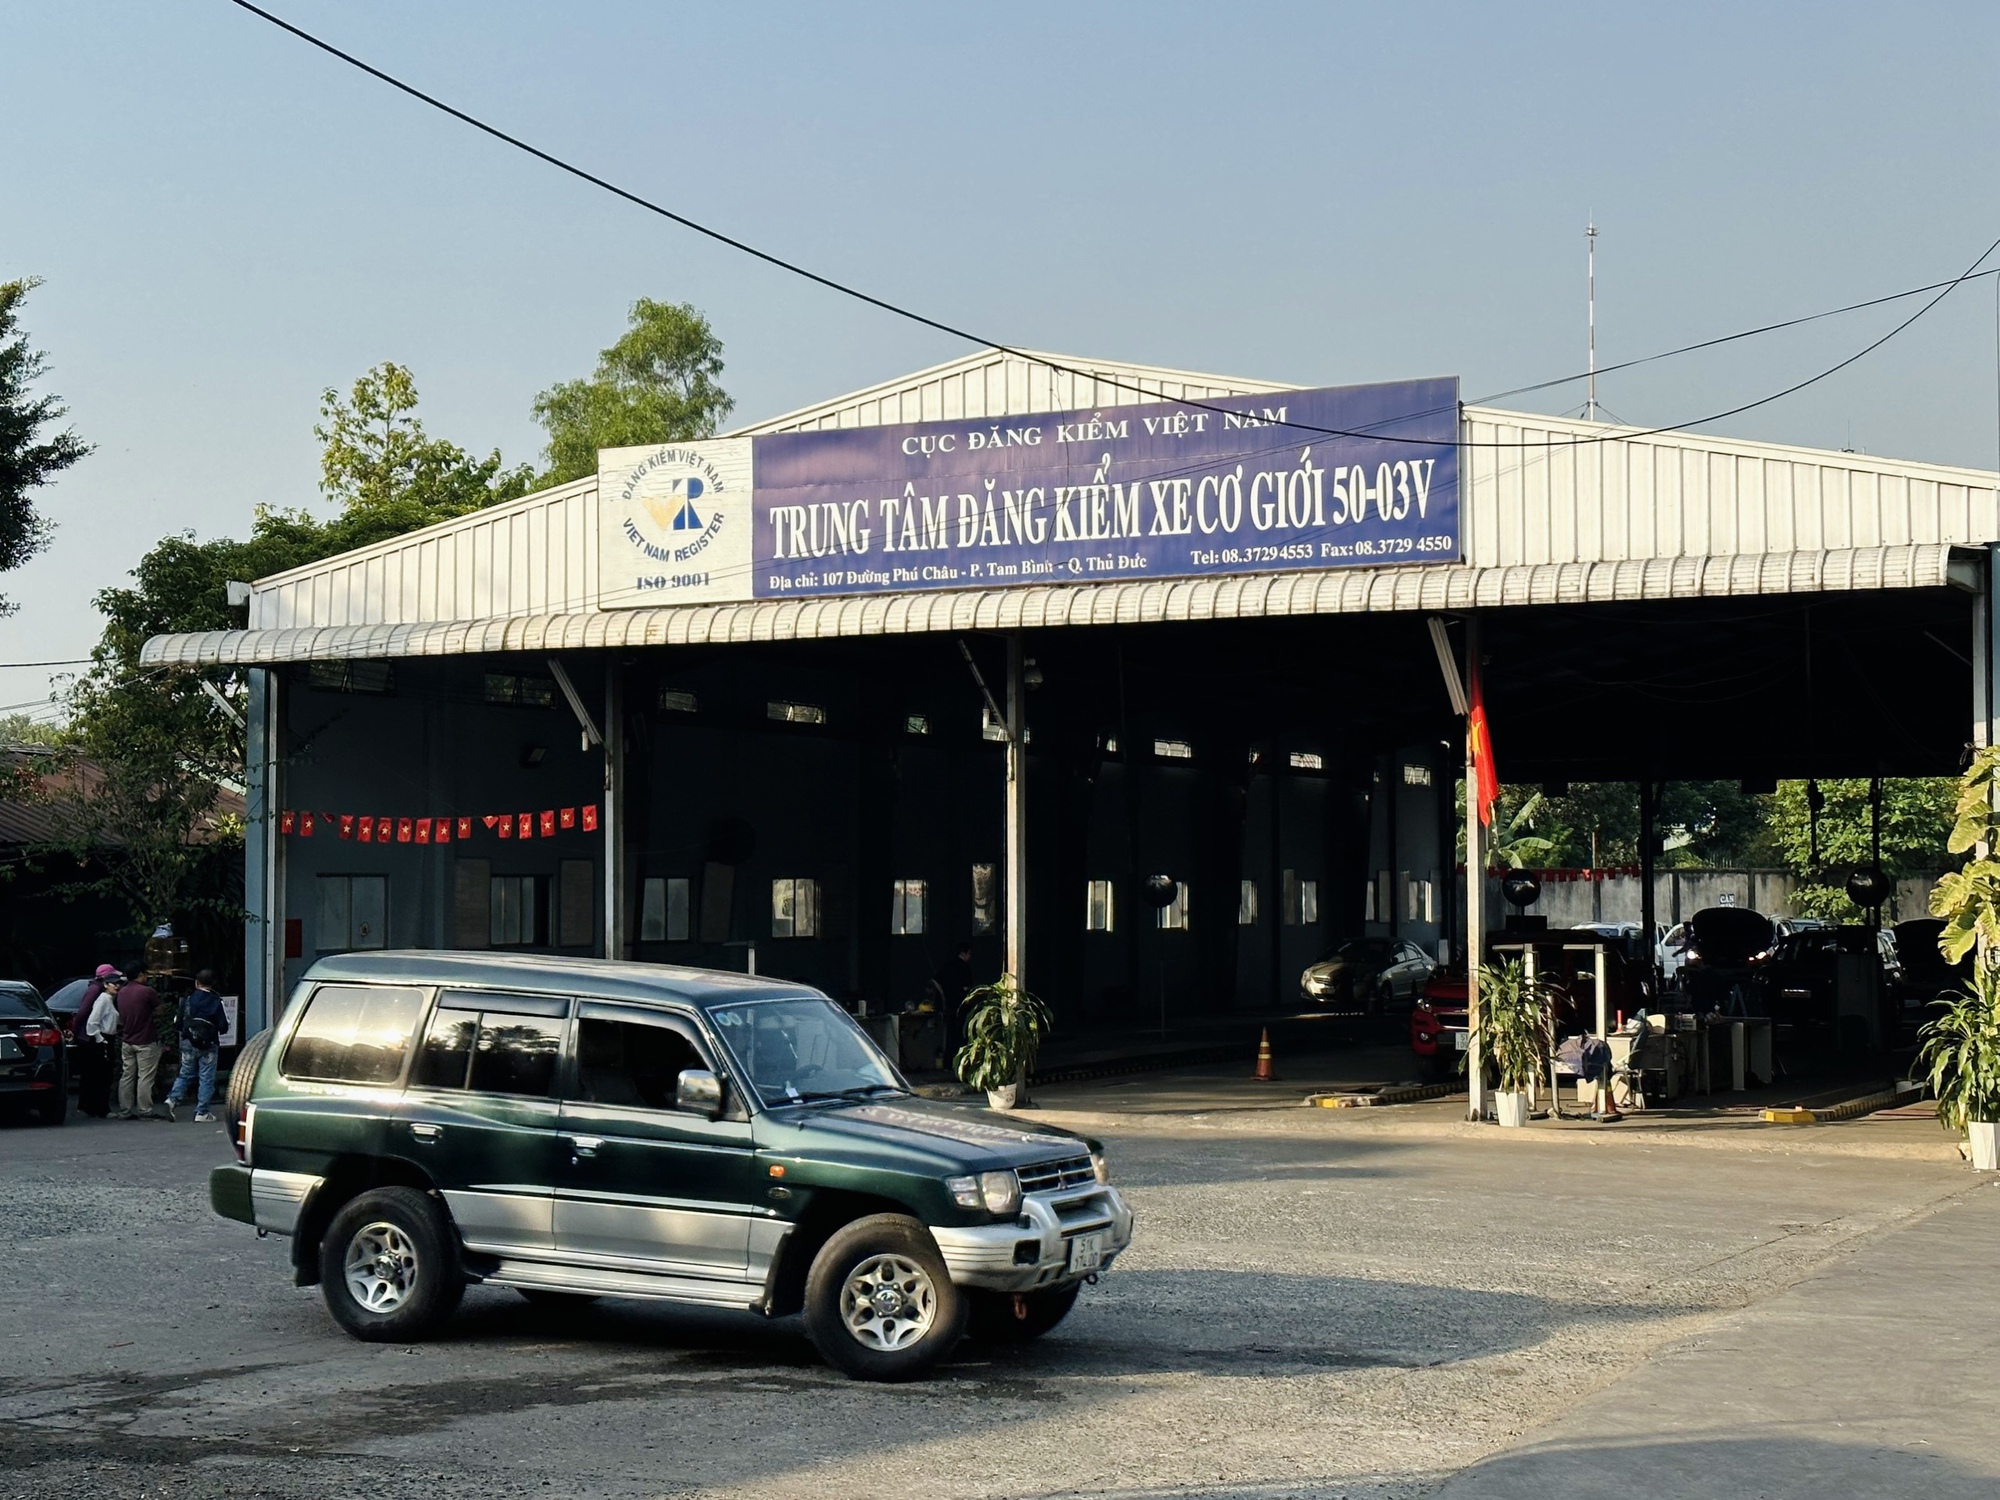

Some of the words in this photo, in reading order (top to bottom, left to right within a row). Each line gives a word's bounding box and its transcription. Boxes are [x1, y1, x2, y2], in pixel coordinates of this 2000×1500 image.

[901, 434, 956, 458] CỤC
[967, 425, 1043, 451] ĐĂNG
[1056, 412, 1129, 443] KIỂM
[1142, 410, 1209, 438] VIỆT
[1223, 406, 1288, 430] NAM
[703, 463, 725, 493] NAM
[769, 499, 871, 560] TRUNG
[880, 481, 949, 553] TÂM
[957, 478, 1047, 549] ĐĂNG
[1053, 452, 1142, 543] KIỂM
[1148, 479, 1193, 537] XE
[1196, 465, 1243, 534] CƠ
[1250, 445, 1326, 531] GIỚI
[1332, 458, 1436, 525] 50-03V
[622, 517, 646, 548] VIET
[643, 542, 670, 562] NAM
[674, 512, 725, 562] REGISTER
[1190, 549, 1219, 565] Tel:
[1321, 542, 1354, 558] Fax:
[1355, 538, 1413, 556] 08.3729
[1416, 535, 1452, 551] 4550
[636, 576, 666, 590] ISO
[671, 572, 710, 587] 9001
[769, 575, 792, 591] Địa
[794, 572, 819, 588] chỉ:
[822, 572, 843, 586] 107
[846, 569, 890, 586] Đường
[893, 566, 918, 582] Phú
[922, 565, 958, 580] Châu
[970, 563, 984, 577] P.
[987, 562, 1018, 576] Tam
[1021, 559, 1053, 575] Bình
[1086, 553, 1114, 571] Thủ
[1118, 552, 1147, 569] Đức
